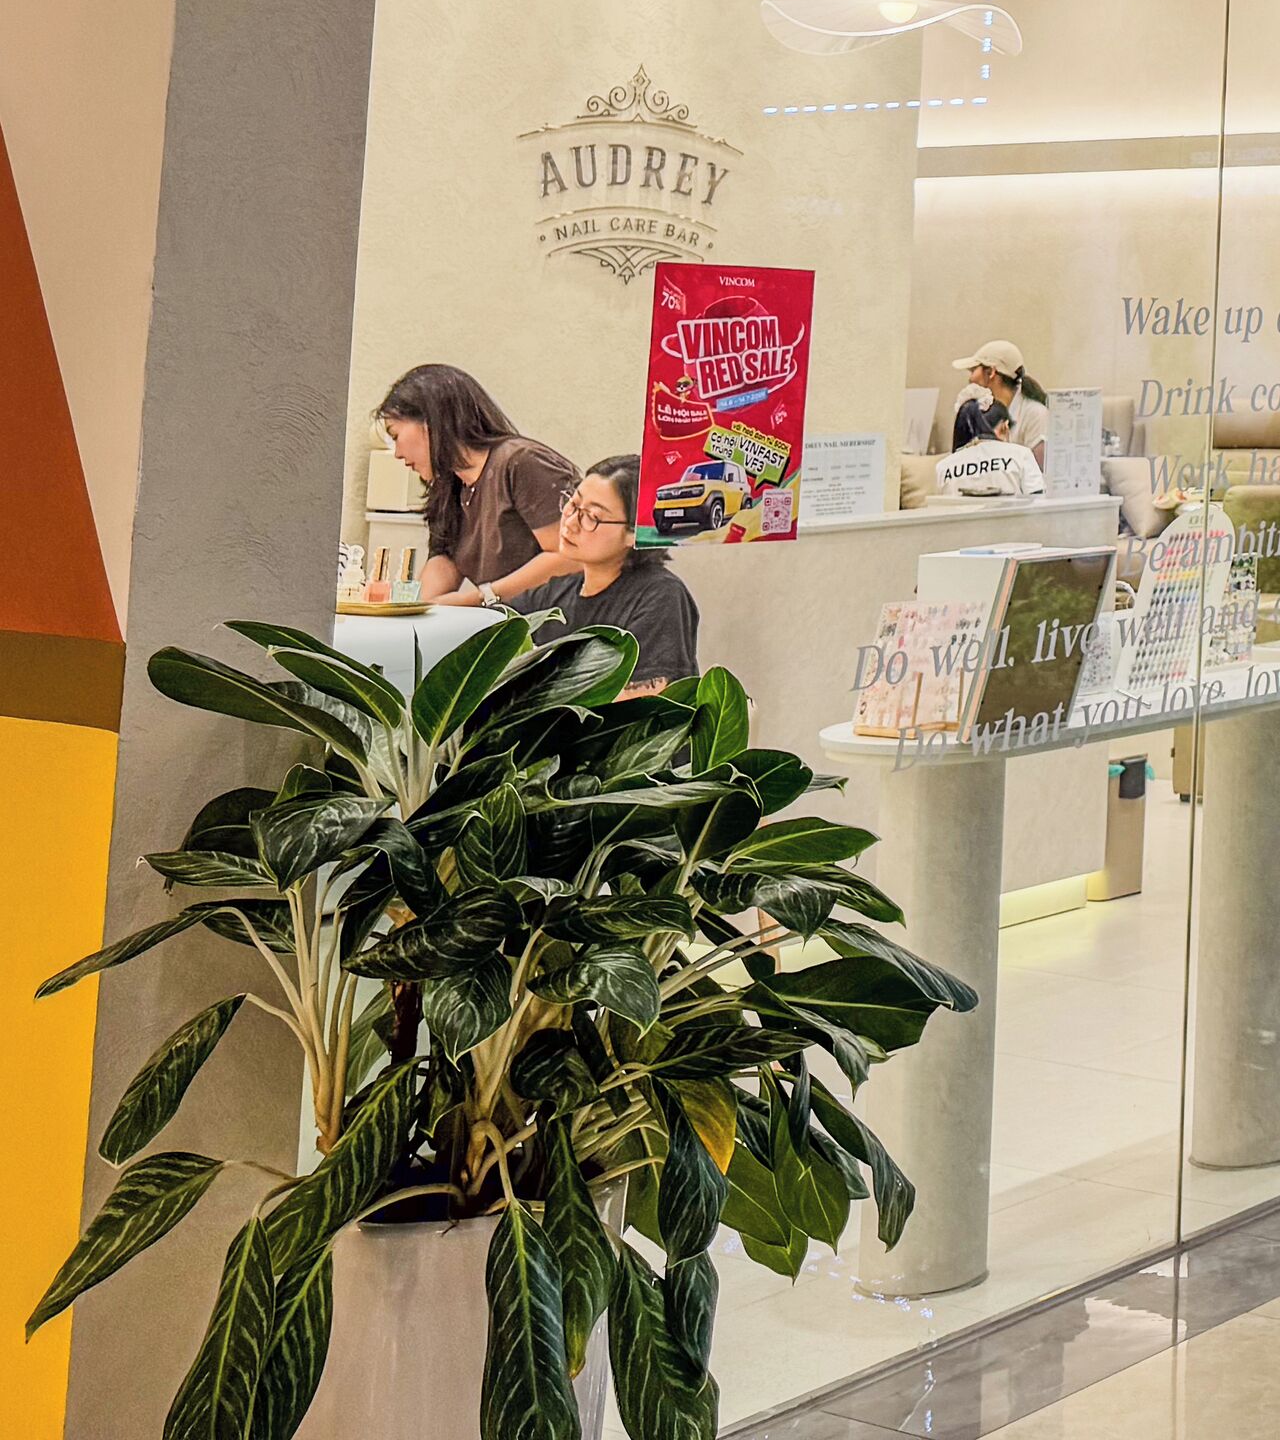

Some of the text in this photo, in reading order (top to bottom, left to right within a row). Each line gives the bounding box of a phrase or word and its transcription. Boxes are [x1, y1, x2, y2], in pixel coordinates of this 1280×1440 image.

[540, 143, 730, 206] AUDREY
[555, 216, 700, 246] NAIL CARE BAR
[660, 291, 681, 310] 70%
[719, 276, 756, 288] VINCOM
[679, 317, 778, 361] VINCOM
[1121, 296, 1211, 336] Wake
[1224, 305, 1263, 344] up
[698, 347, 791, 396] RED SALE
[1135, 376, 1238, 418] Drink
[740, 437, 785, 466] VINFAST
[745, 455, 765, 473] VF3
[944, 457, 1013, 481] AUDREY
[1149, 452, 1233, 495] Work
[1120, 535, 1164, 578] Be
[850, 643, 909, 691] Do
[1031, 617, 1101, 665] live
[1117, 600, 1188, 648] well
[1199, 589, 1260, 636] and
[891, 724, 948, 774] Do
[970, 701, 1065, 757] what
[1074, 694, 1152, 748] you
